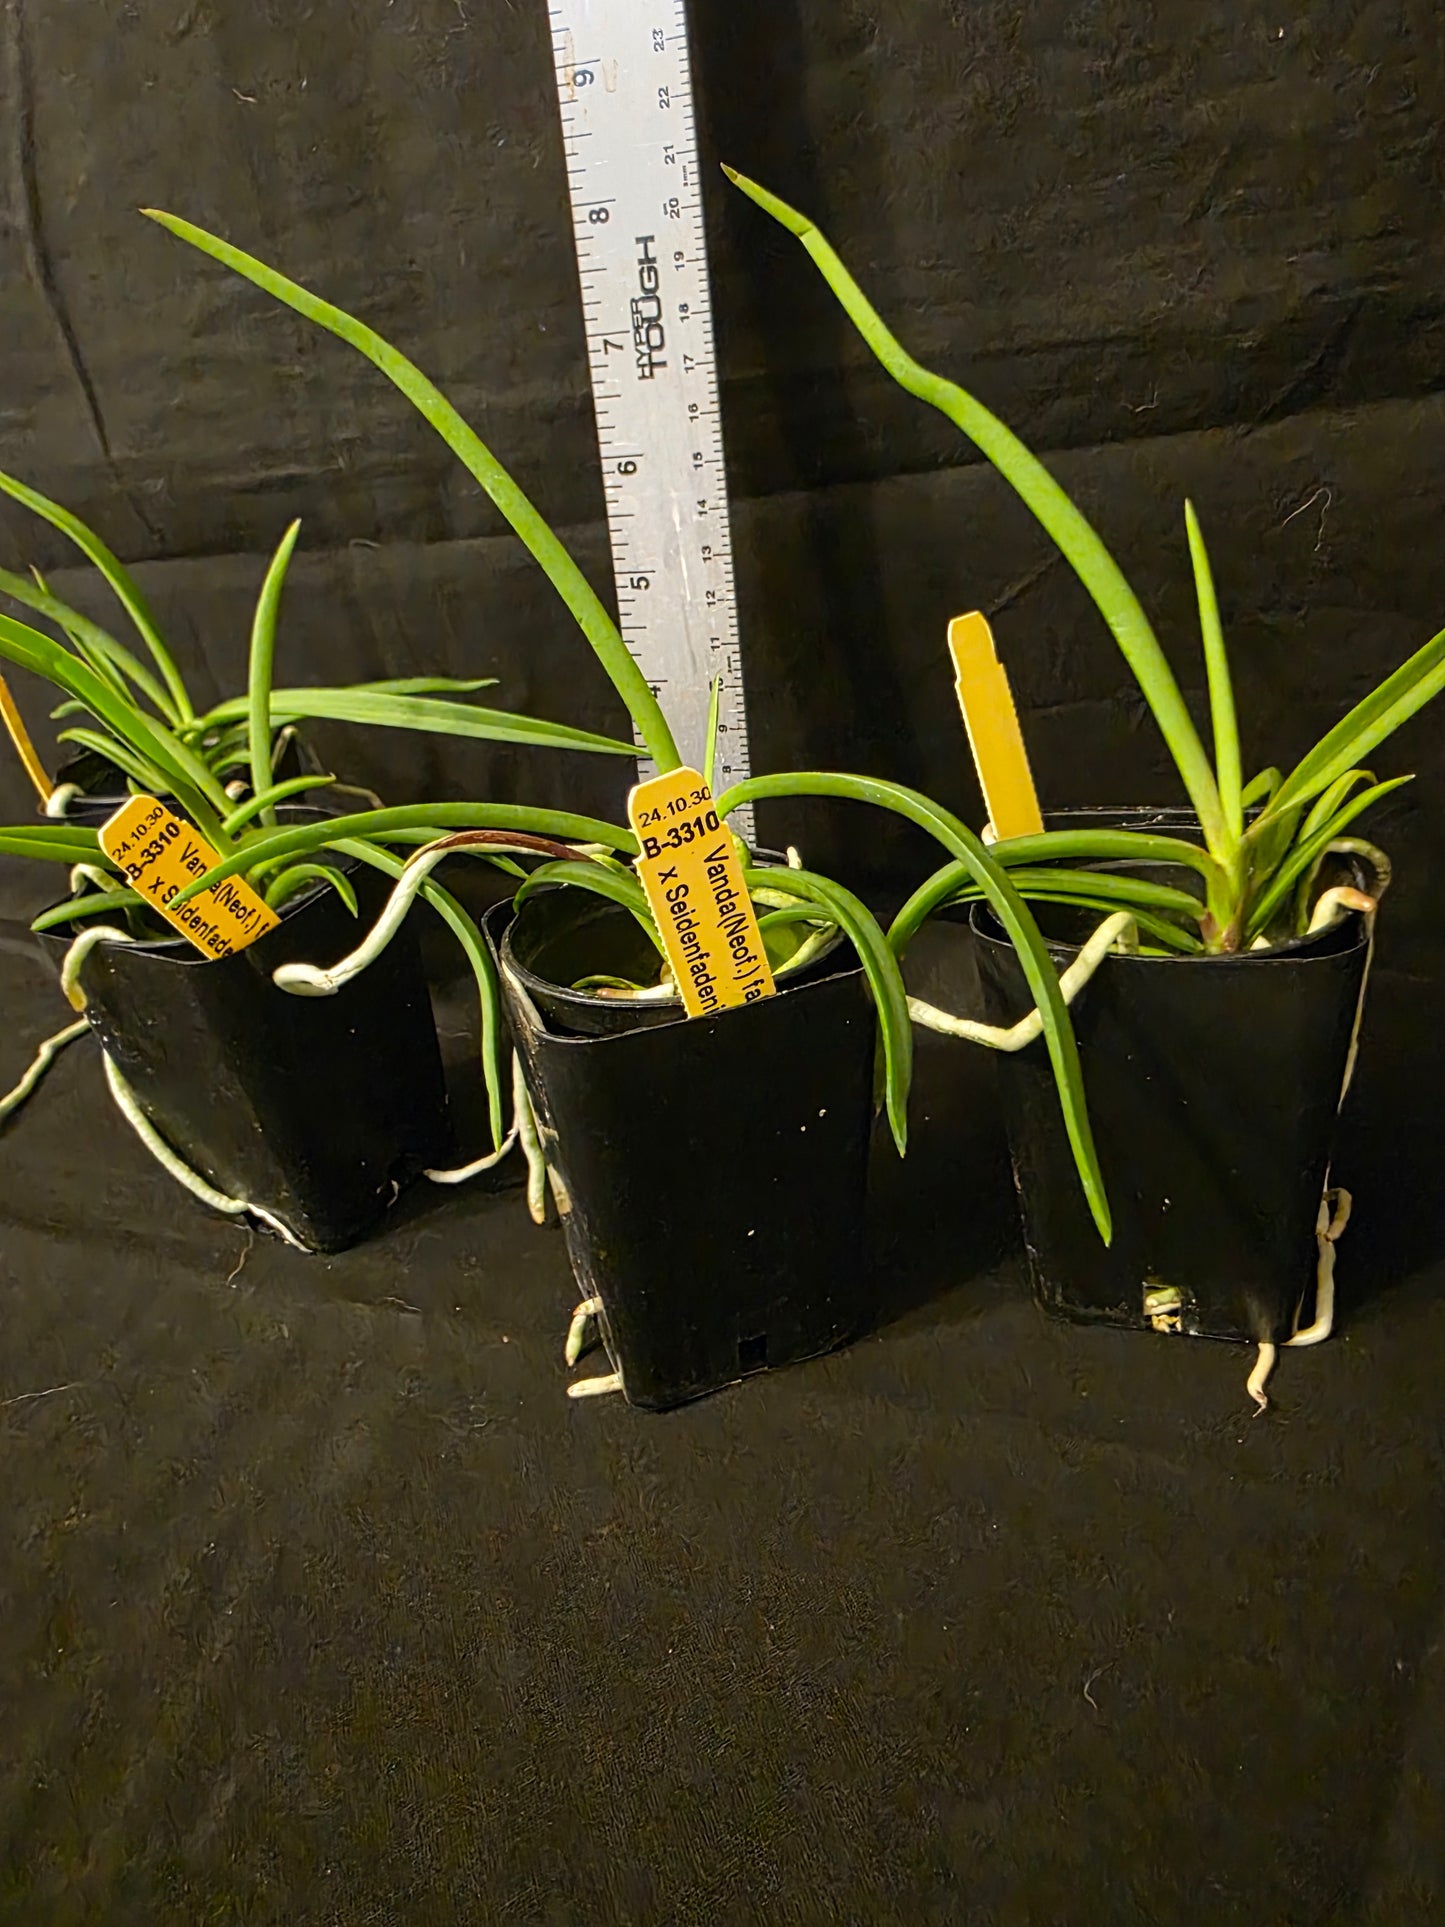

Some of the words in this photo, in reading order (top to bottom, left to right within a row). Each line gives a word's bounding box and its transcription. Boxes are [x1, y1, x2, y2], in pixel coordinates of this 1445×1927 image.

[652, 28, 665, 52] 23
[572, 69, 595, 88] 9
[658, 86, 671, 109] 22
[663, 144, 676, 165] 21
[588, 207, 610, 224] 8
[669, 197, 681, 219] 20
[673, 251, 686, 271] 19
[635, 235, 668, 379] TOUGH
[678, 302, 690, 323] 18
[603, 338, 624, 355] 7
[630, 298, 655, 381] HYPER
[683, 354, 695, 373] 17
[688, 403, 700, 423] 16
[617, 460, 638, 476] 6
[692, 452, 704, 471] 15
[698, 499, 708, 517] 14
[701, 545, 713, 563] 13
[630, 576, 651, 591] 5
[706, 590, 717, 607] 12
[710, 636, 720, 652] 11
[719, 724, 728, 733] 9
[722, 765, 732, 774] 8
[638, 786, 712, 828] 24.10.30
[112, 806, 164, 861] 24.10.30
[642, 810, 720, 860] B-3310
[125, 822, 181, 881] B-3310
[147, 876, 165, 894] x
[658, 866, 678, 885] x
[179, 841, 262, 935] Vana(Neof.)
[703, 844, 761, 981] Vanda(Neof.)
